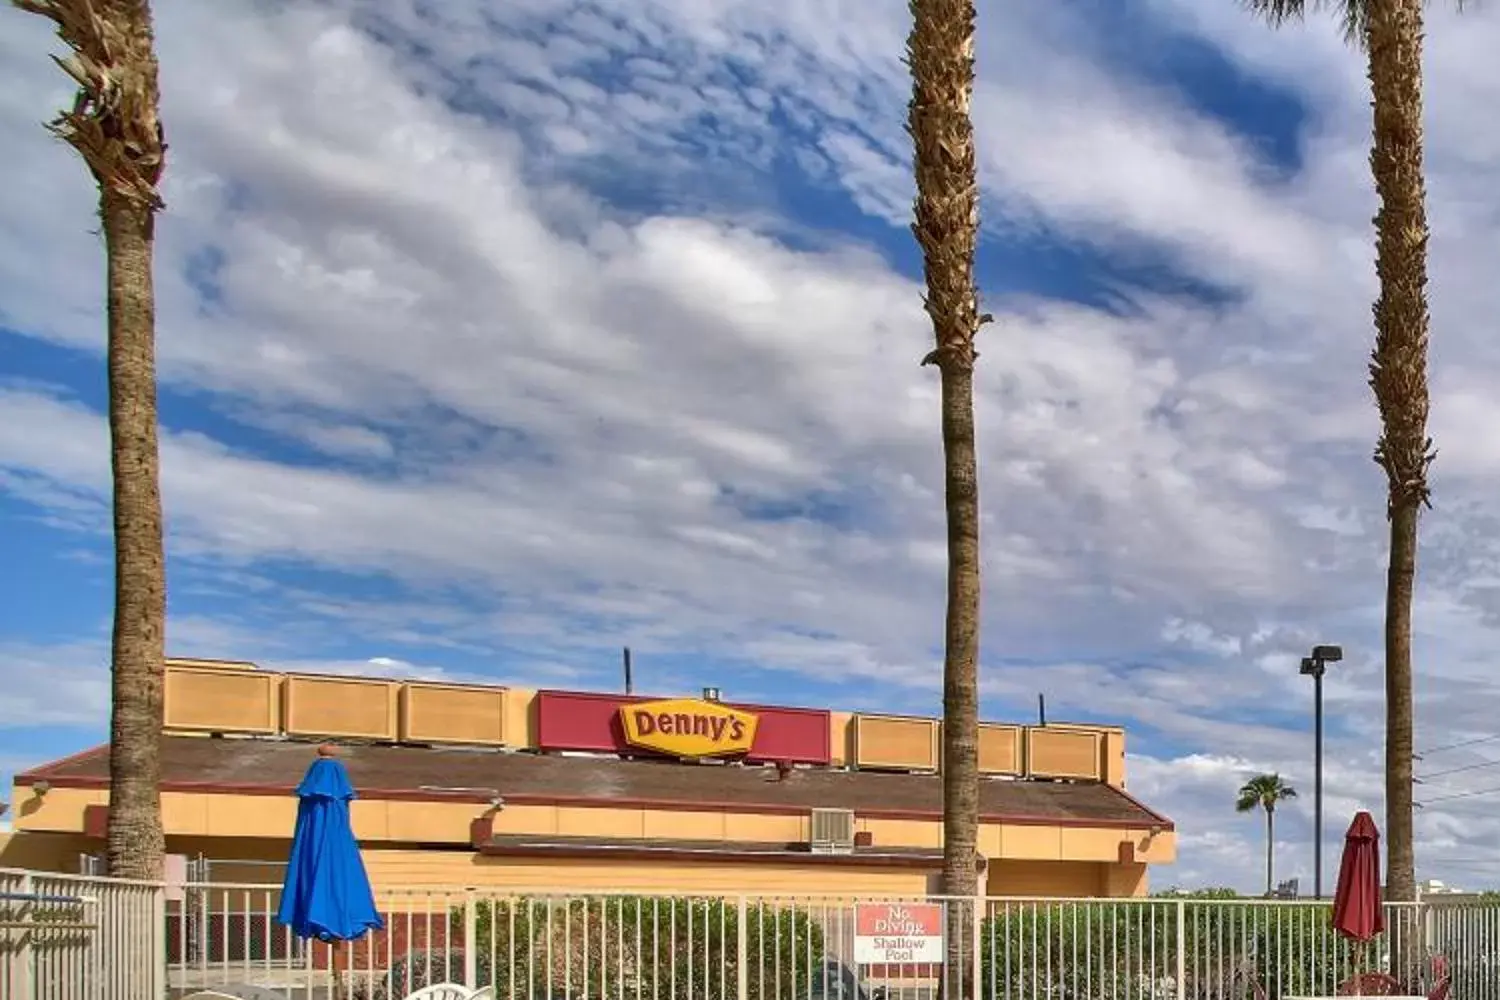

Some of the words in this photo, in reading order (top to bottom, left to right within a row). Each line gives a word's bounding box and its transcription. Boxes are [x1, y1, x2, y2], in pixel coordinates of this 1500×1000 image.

[635, 710, 746, 741] Denny's
[889, 905, 910, 920] No
[874, 920, 925, 936] Diving
[873, 937, 926, 949] Shallow
[885, 949, 913, 961] Pool
